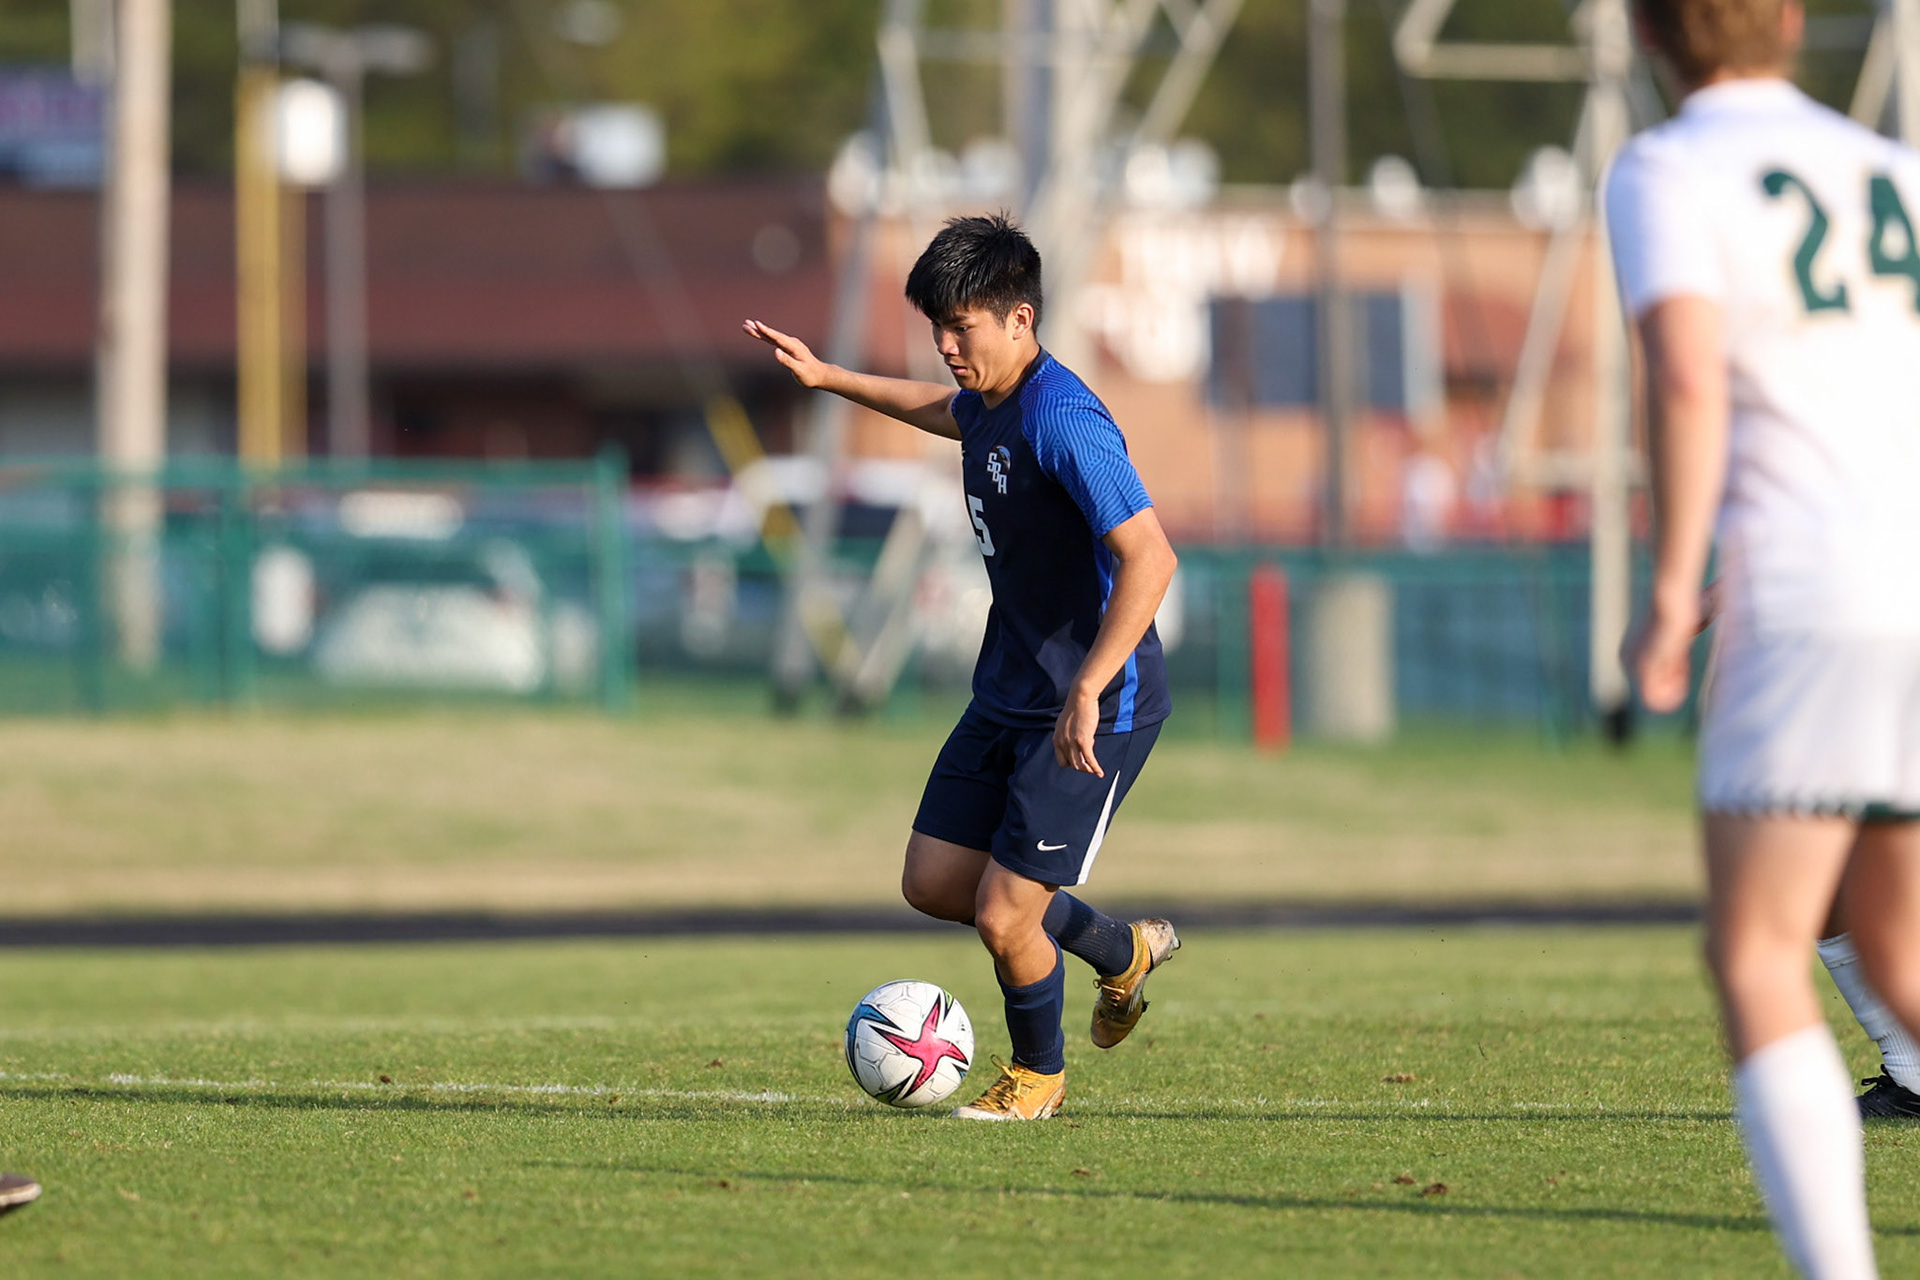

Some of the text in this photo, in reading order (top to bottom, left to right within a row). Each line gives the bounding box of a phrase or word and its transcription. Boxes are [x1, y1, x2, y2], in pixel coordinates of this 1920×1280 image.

[1762, 168, 1920, 315] 24
[987, 452, 1007, 494] SBA
[968, 494, 996, 557] 5
